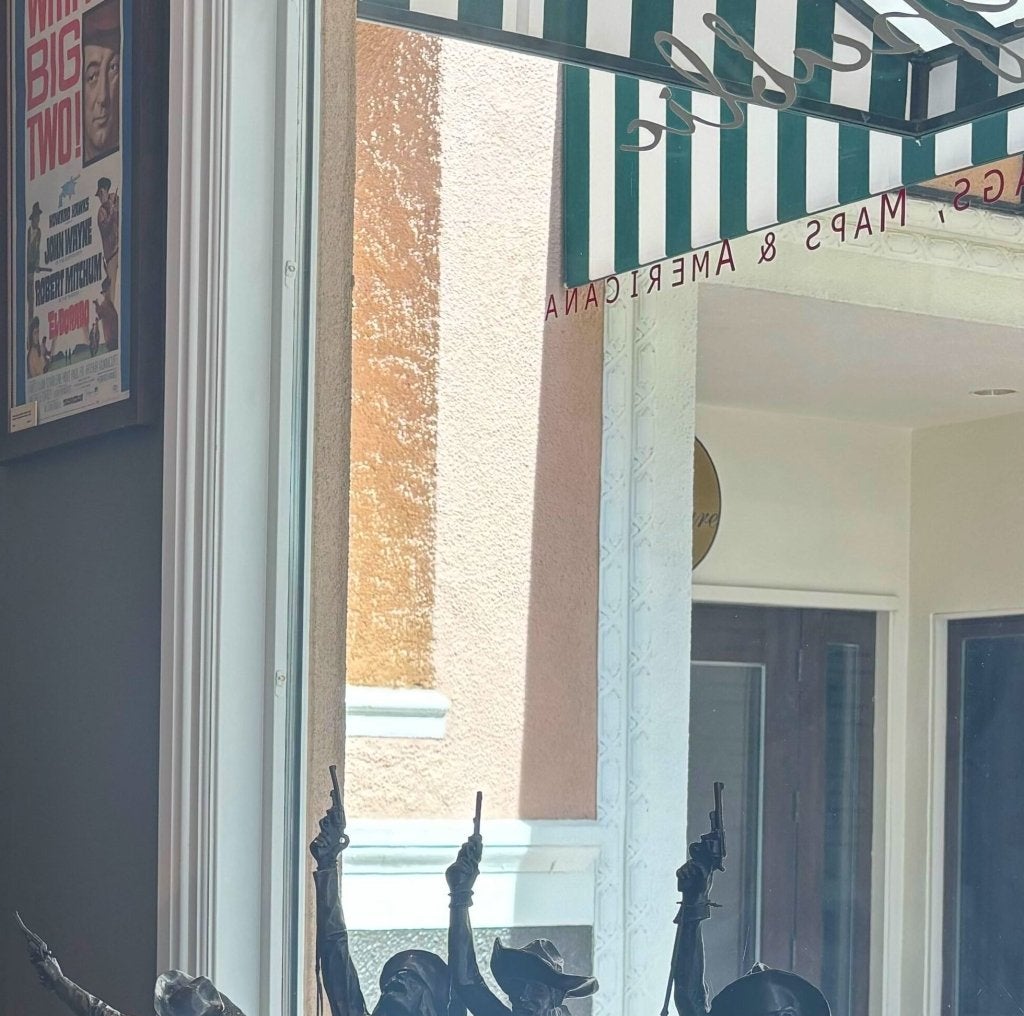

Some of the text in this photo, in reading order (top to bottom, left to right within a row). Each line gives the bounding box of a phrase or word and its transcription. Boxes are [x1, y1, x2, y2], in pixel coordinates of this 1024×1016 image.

[27, 18, 81, 111] BIG
[26, 91, 81, 182] TWO!
[64, 217, 93, 256] WAYNE
[34, 269, 65, 307] ROBERT
